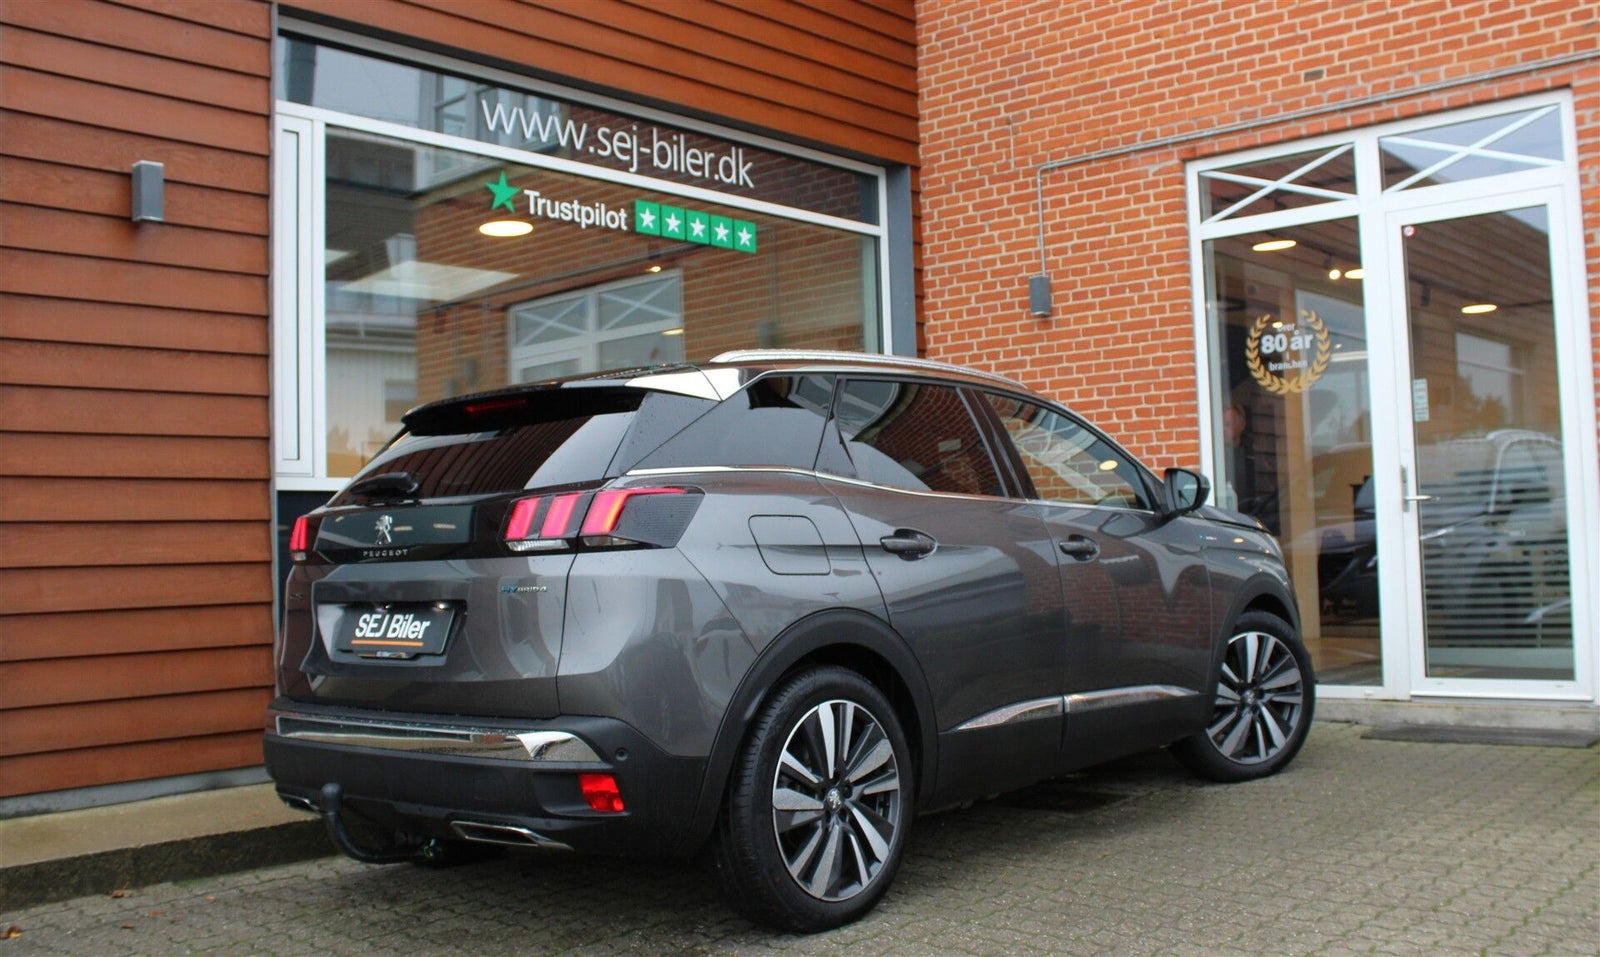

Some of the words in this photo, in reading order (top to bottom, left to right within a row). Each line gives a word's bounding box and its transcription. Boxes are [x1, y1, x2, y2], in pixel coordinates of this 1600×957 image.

[481, 98, 755, 188] www.sej-biler.dk
[524, 189, 628, 231] Trustpilot
[1260, 333, 1288, 354] 80
[1290, 329, 1314, 350] år
[362, 548, 409, 558] PEUGEOT
[355, 613, 388, 638] SEJ
[387, 614, 431, 639] Biler
